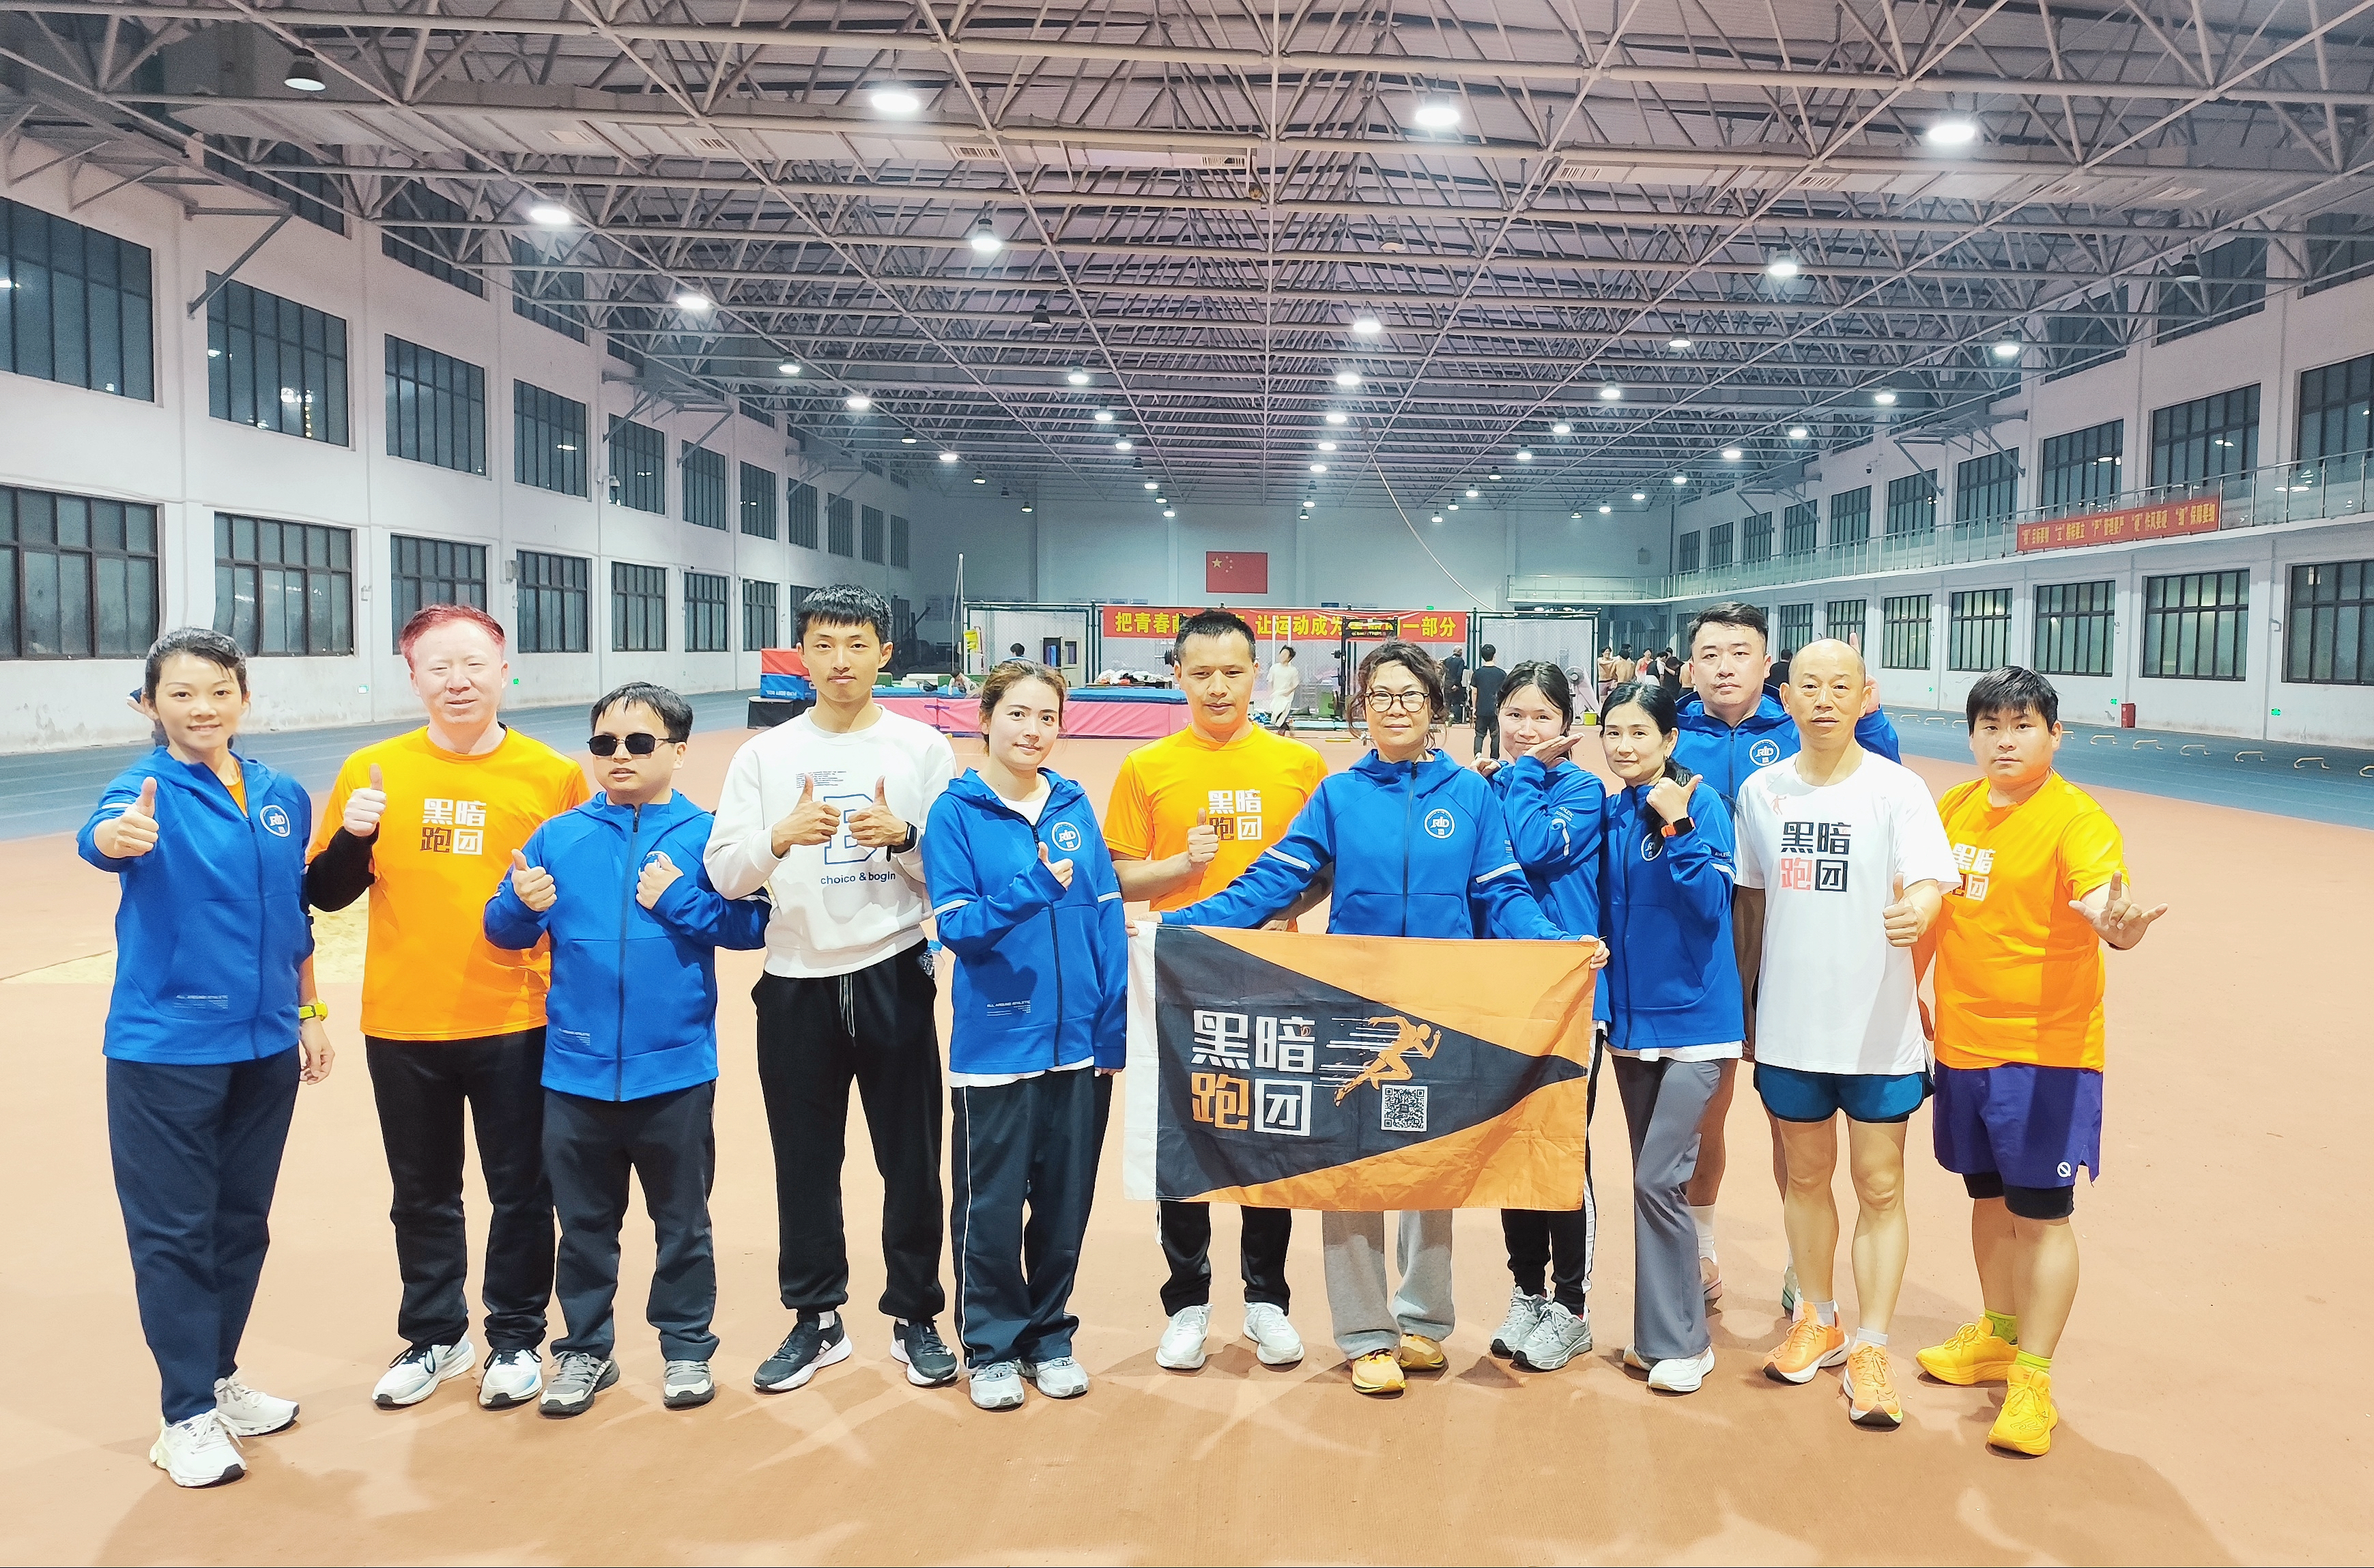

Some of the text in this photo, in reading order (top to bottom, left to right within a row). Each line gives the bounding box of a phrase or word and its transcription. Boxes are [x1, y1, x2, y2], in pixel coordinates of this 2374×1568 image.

[421, 798, 487, 827] 黑暗
[1207, 789, 1261, 814] 黑暗
[420, 827, 484, 855] 跑团
[1209, 816, 1262, 840] 跑团
[1781, 822, 1852, 855] 黑暗
[859, 872, 867, 881] &
[1781, 857, 1848, 892] 跑团
[1190, 1010, 1316, 1073] 黑暗
[1190, 1072, 1313, 1137] 跑团
